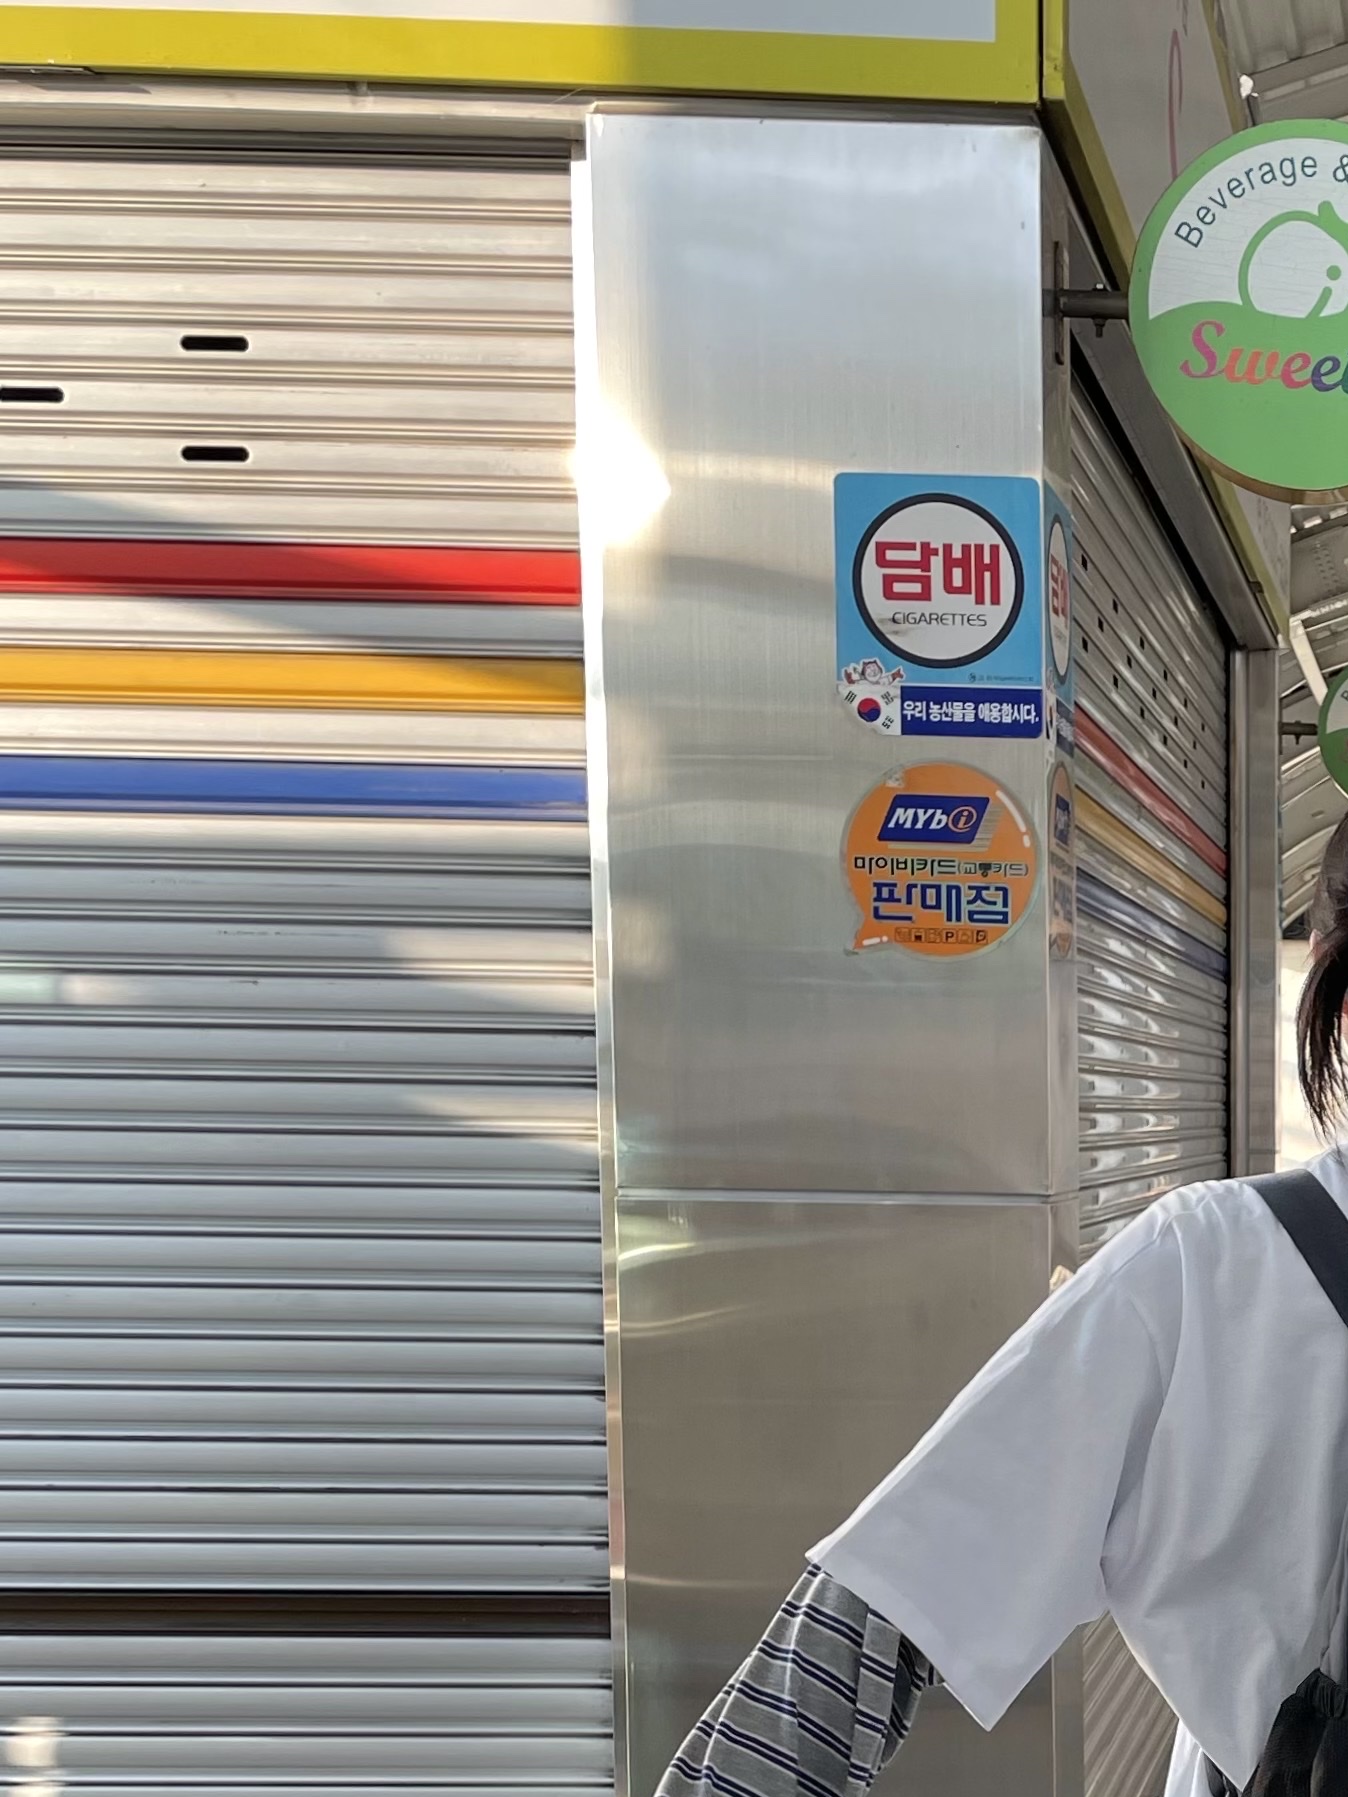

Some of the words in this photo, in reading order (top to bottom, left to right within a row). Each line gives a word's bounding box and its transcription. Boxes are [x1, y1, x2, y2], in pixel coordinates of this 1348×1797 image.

[1174, 155, 1317, 248] Beverage
[874, 540, 1002, 606] 담배
[891, 611, 988, 627] CIGARETTES
[902, 700, 927, 721] 우리
[929, 701, 976, 722] 농산물을
[978, 702, 1040, 724] 애용합시다.
[872, 881, 1010, 925] 판매점
